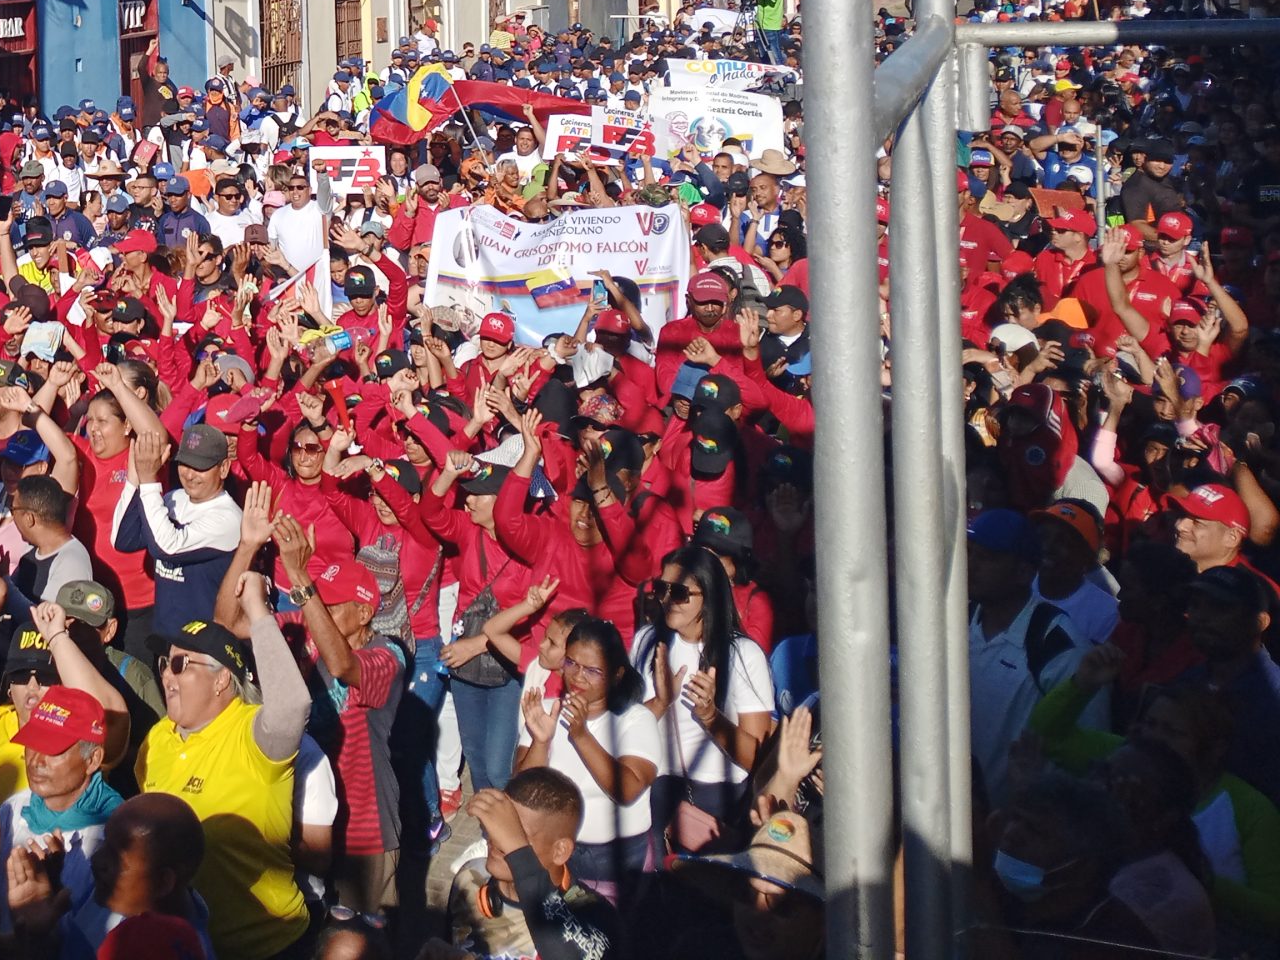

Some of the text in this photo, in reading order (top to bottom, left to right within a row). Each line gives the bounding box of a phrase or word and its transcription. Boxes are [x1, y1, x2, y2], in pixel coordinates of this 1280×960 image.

[120, 0, 146, 30] VIP
[0, 17, 25, 39] BAR
[737, 107, 763, 118] Cortés
[571, 216, 621, 225] VIVIENDO
[479, 235, 511, 256] JUAN
[596, 240, 648, 254] FALCÓN
